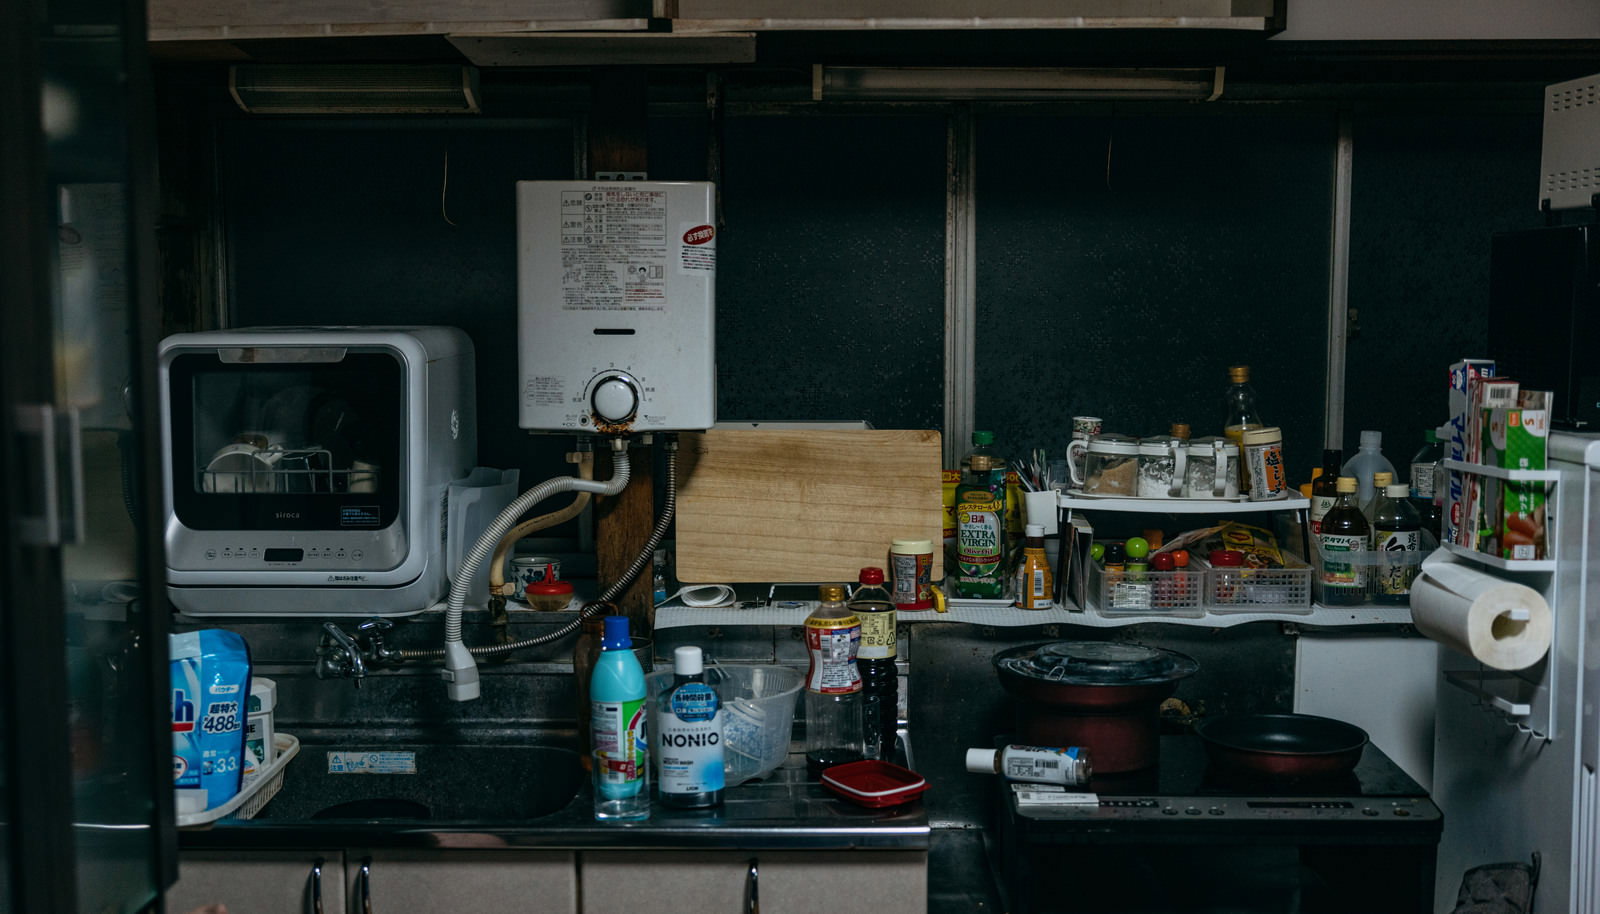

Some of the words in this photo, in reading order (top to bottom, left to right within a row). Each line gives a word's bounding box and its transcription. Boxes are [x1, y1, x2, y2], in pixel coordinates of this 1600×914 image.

[961, 530, 995, 538] EXTRA
[961, 538, 996, 547] VIRGIN
[210, 702, 237, 713] 超特大
[662, 732, 719, 747] NONIO
